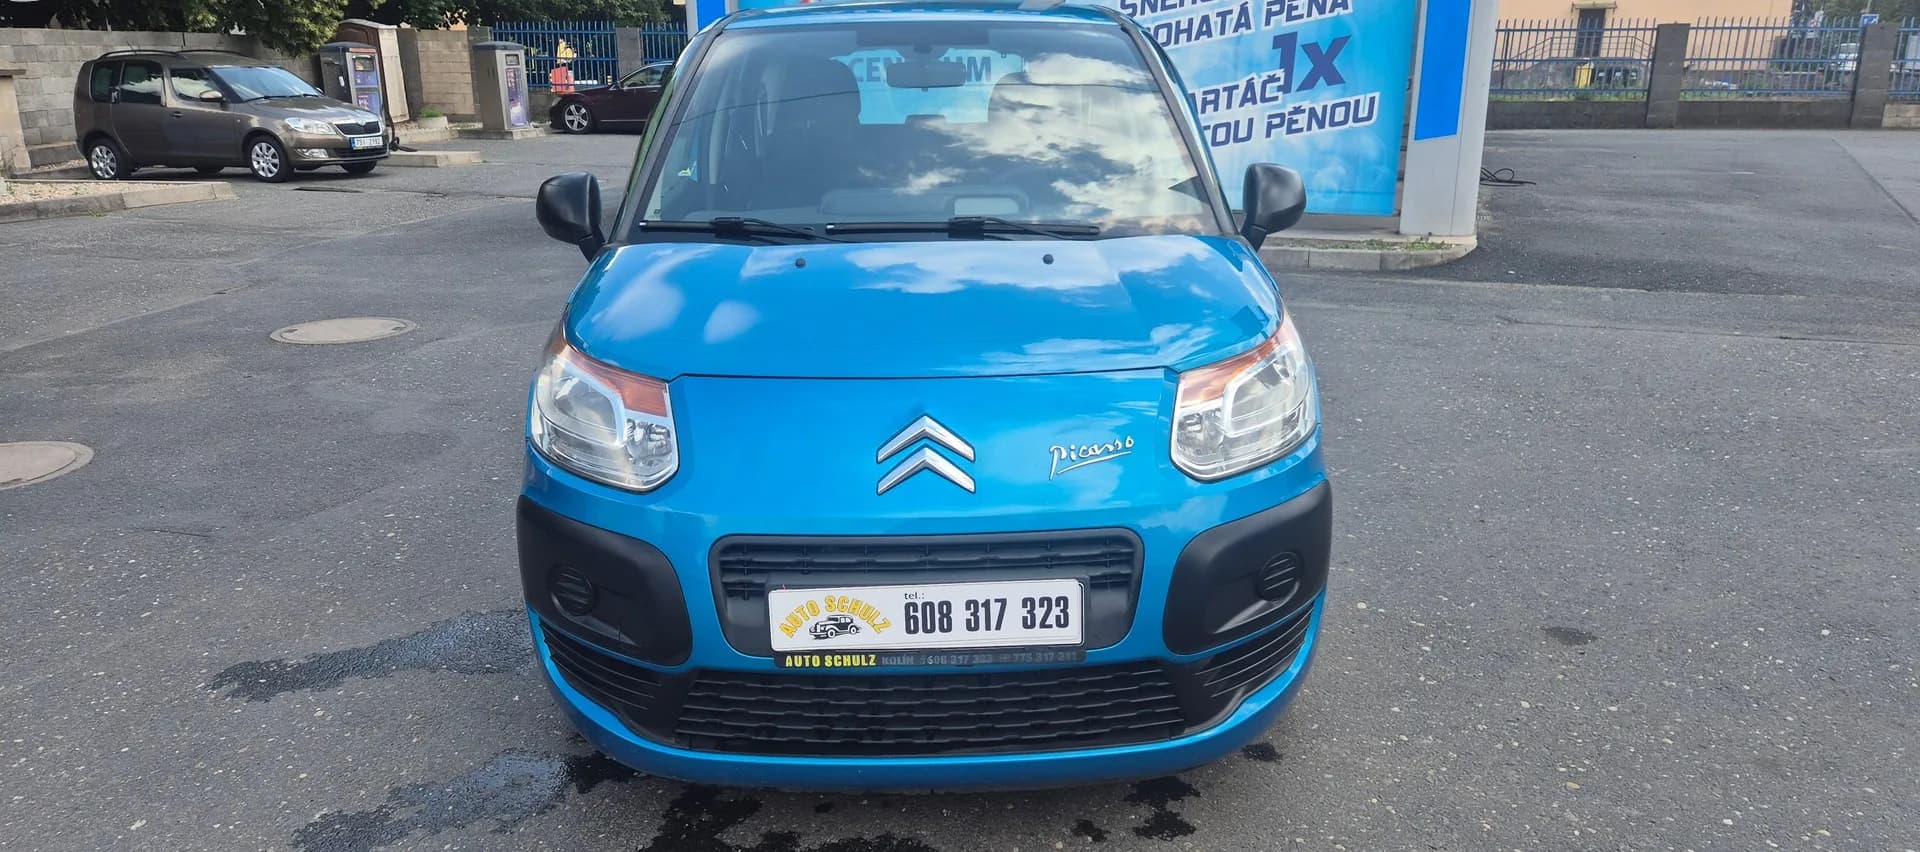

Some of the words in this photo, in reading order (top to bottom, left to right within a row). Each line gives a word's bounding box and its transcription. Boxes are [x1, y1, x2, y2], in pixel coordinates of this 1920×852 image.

[1145, 1, 1252, 48] OHATÁ
[1188, 74, 1281, 115] RTÁČ
[1203, 117, 1254, 148] OU
[1265, 96, 1376, 139] PĚNOU
[779, 600, 821, 638] AUTO
[824, 594, 893, 635] SCHULZ
[904, 591, 925, 600] tel.:
[904, 600, 952, 635] 608
[965, 598, 1008, 632] 317
[1021, 596, 1070, 630] 323
[785, 655, 821, 667] AUTO
[824, 654, 877, 667] SCHULZ
[881, 653, 914, 665] KOLÍN
